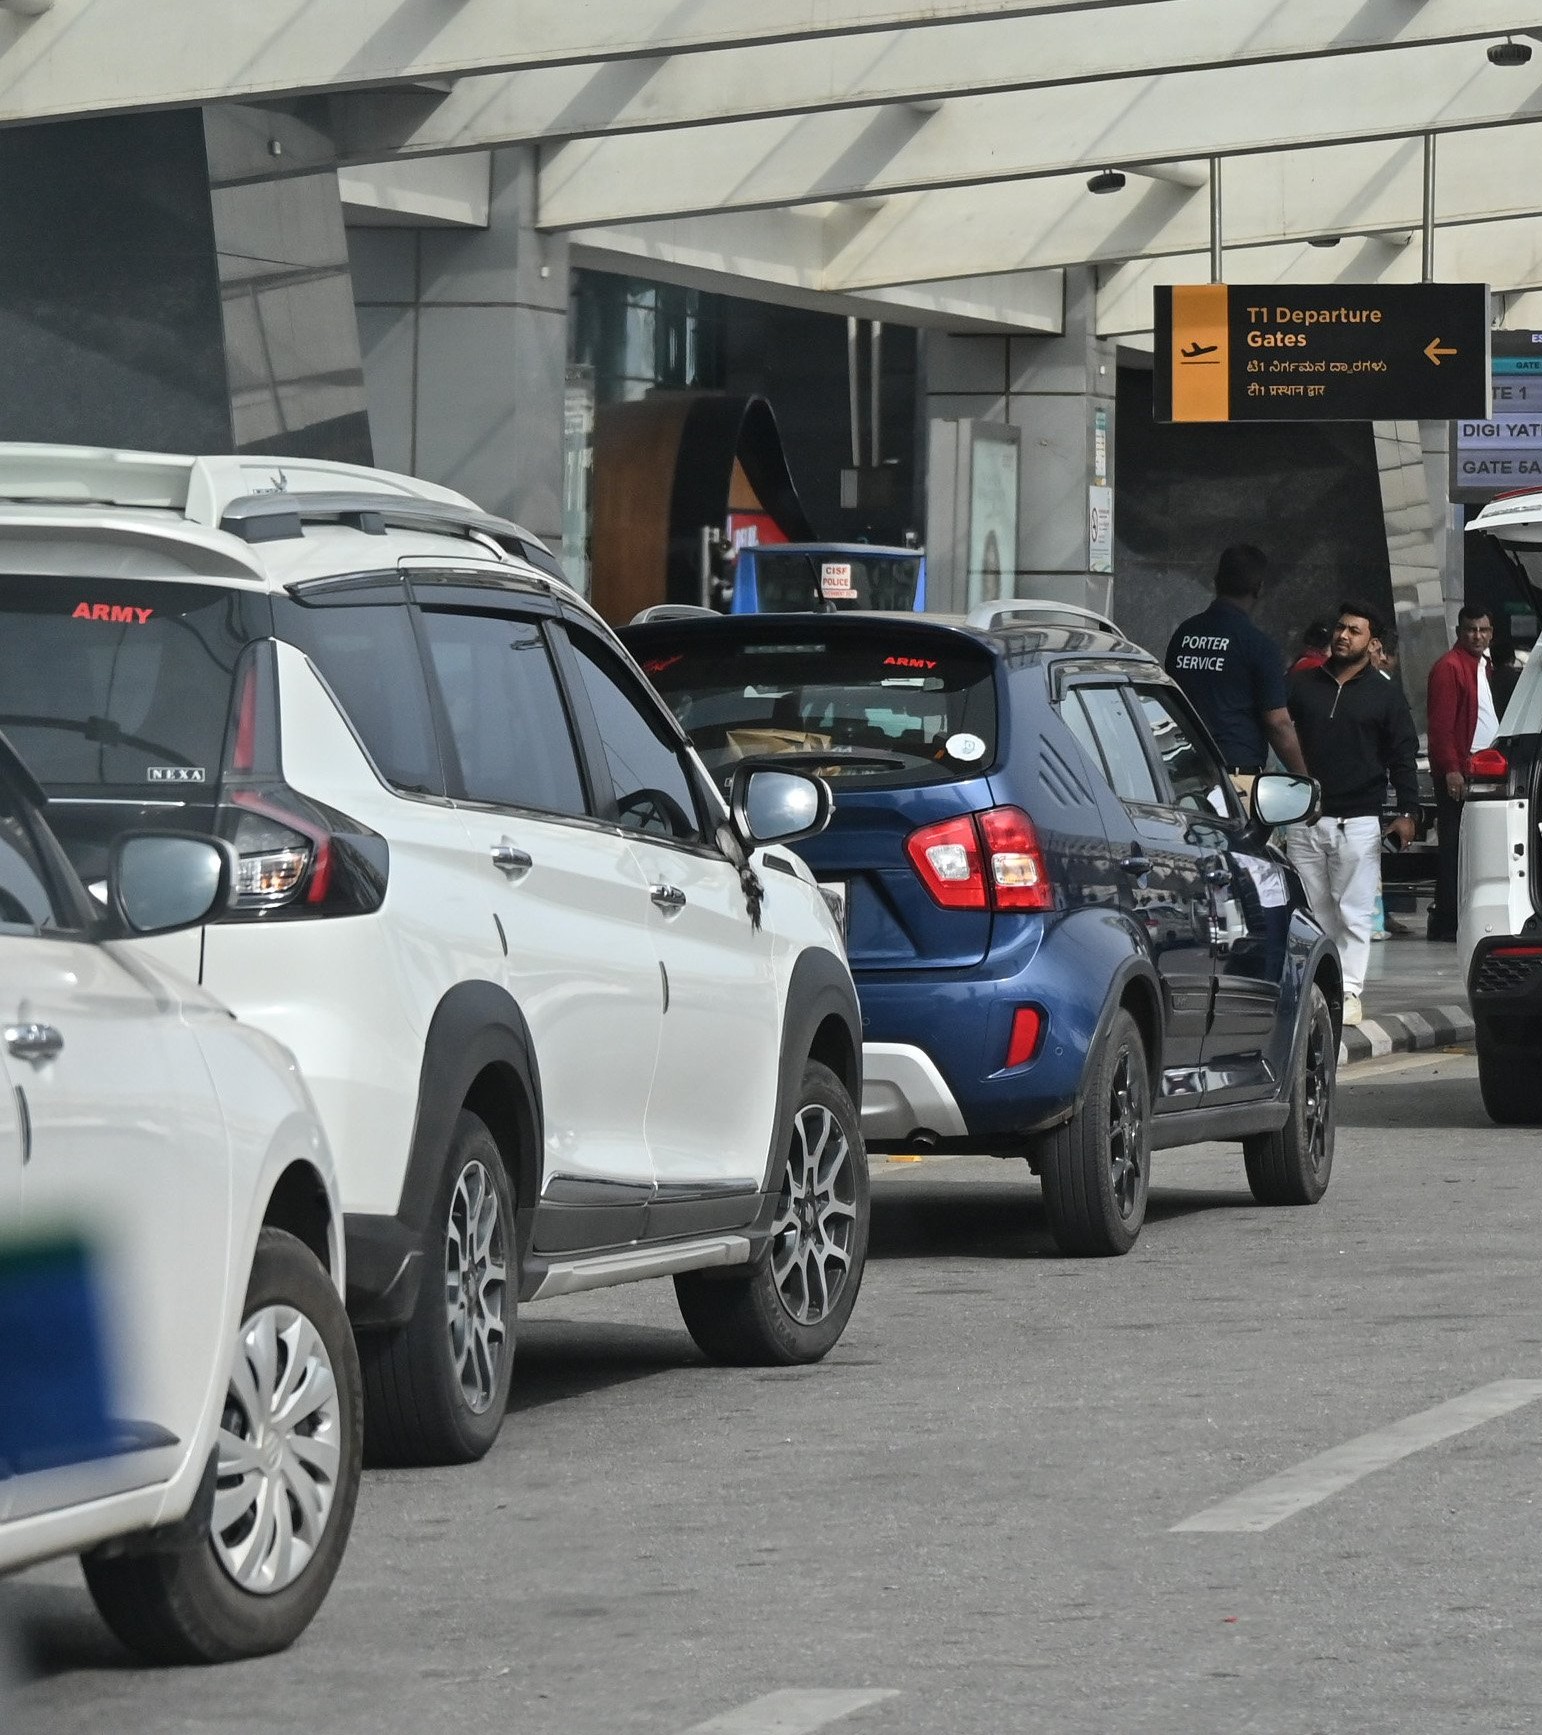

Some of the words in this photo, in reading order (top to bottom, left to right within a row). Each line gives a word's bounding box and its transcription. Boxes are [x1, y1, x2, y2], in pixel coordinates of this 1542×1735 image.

[1246, 307, 1268, 323] T1
[1276, 307, 1382, 326] Departure
[1246, 330, 1307, 347] Gates
[1246, 360, 1265, 373] ಟಿ1
[1516, 361, 1540, 369] GATE
[1247, 382, 1265, 396] टी1
[1269, 385, 1303, 396] प्रस्थान
[1306, 385, 1326, 397] द्वार
[1519, 386, 1527, 400] 1
[1463, 423, 1500, 437] DIGI
[1463, 460, 1512, 474] GATE
[825, 566, 848, 575] CISF
[822, 578, 849, 587] POLICE
[71, 602, 154, 625] ARMY
[1181, 635, 1230, 651] PORTER
[883, 656, 937, 669] ARMY
[1175, 655, 1225, 671] SERVICE
[152, 769, 202, 781] NEXA
